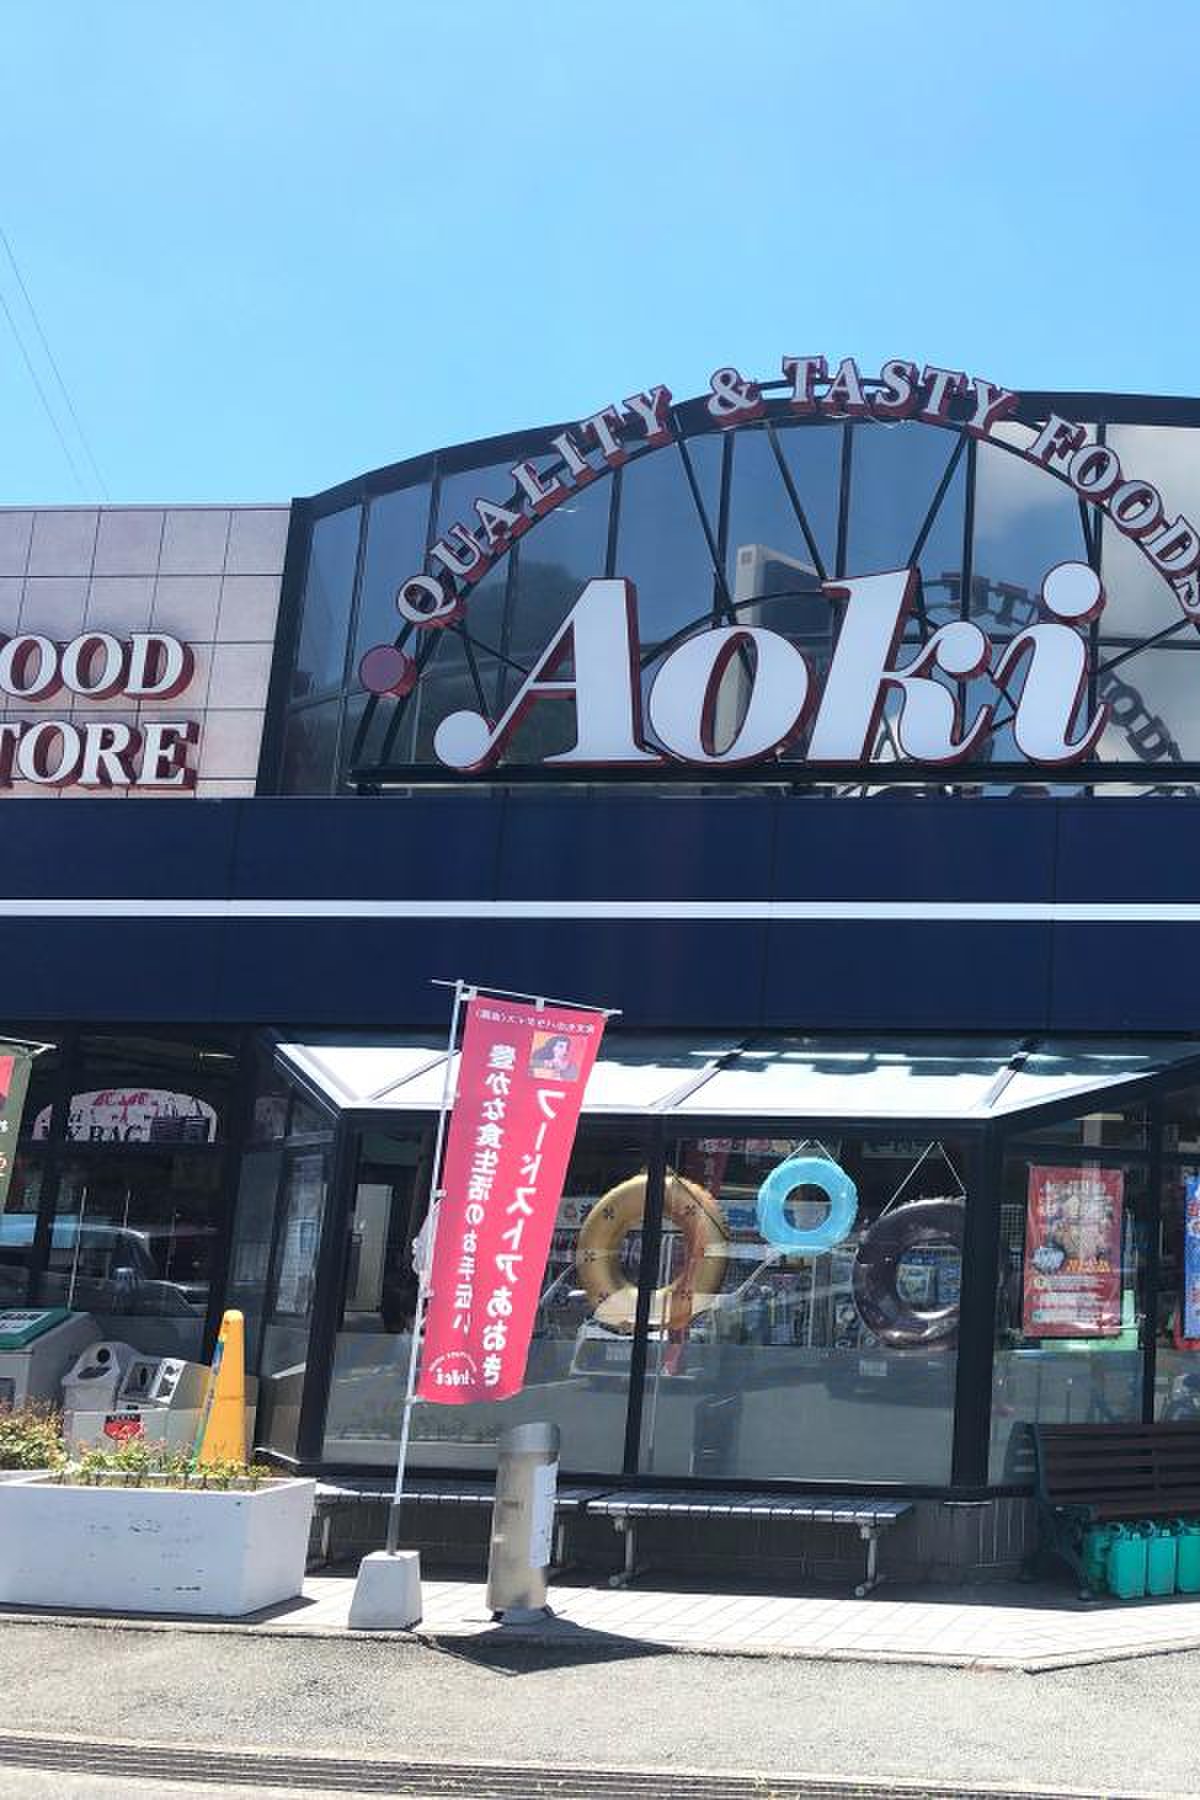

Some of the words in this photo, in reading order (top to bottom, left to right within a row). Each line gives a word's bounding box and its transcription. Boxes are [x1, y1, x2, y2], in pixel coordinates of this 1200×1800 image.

[396, 384, 673, 627] QUALITY
[706, 367, 764, 427] &
[782, 355, 1017, 436] TASTY
[0, 632, 194, 703] OOD
[433, 560, 1109, 773] Aoki
